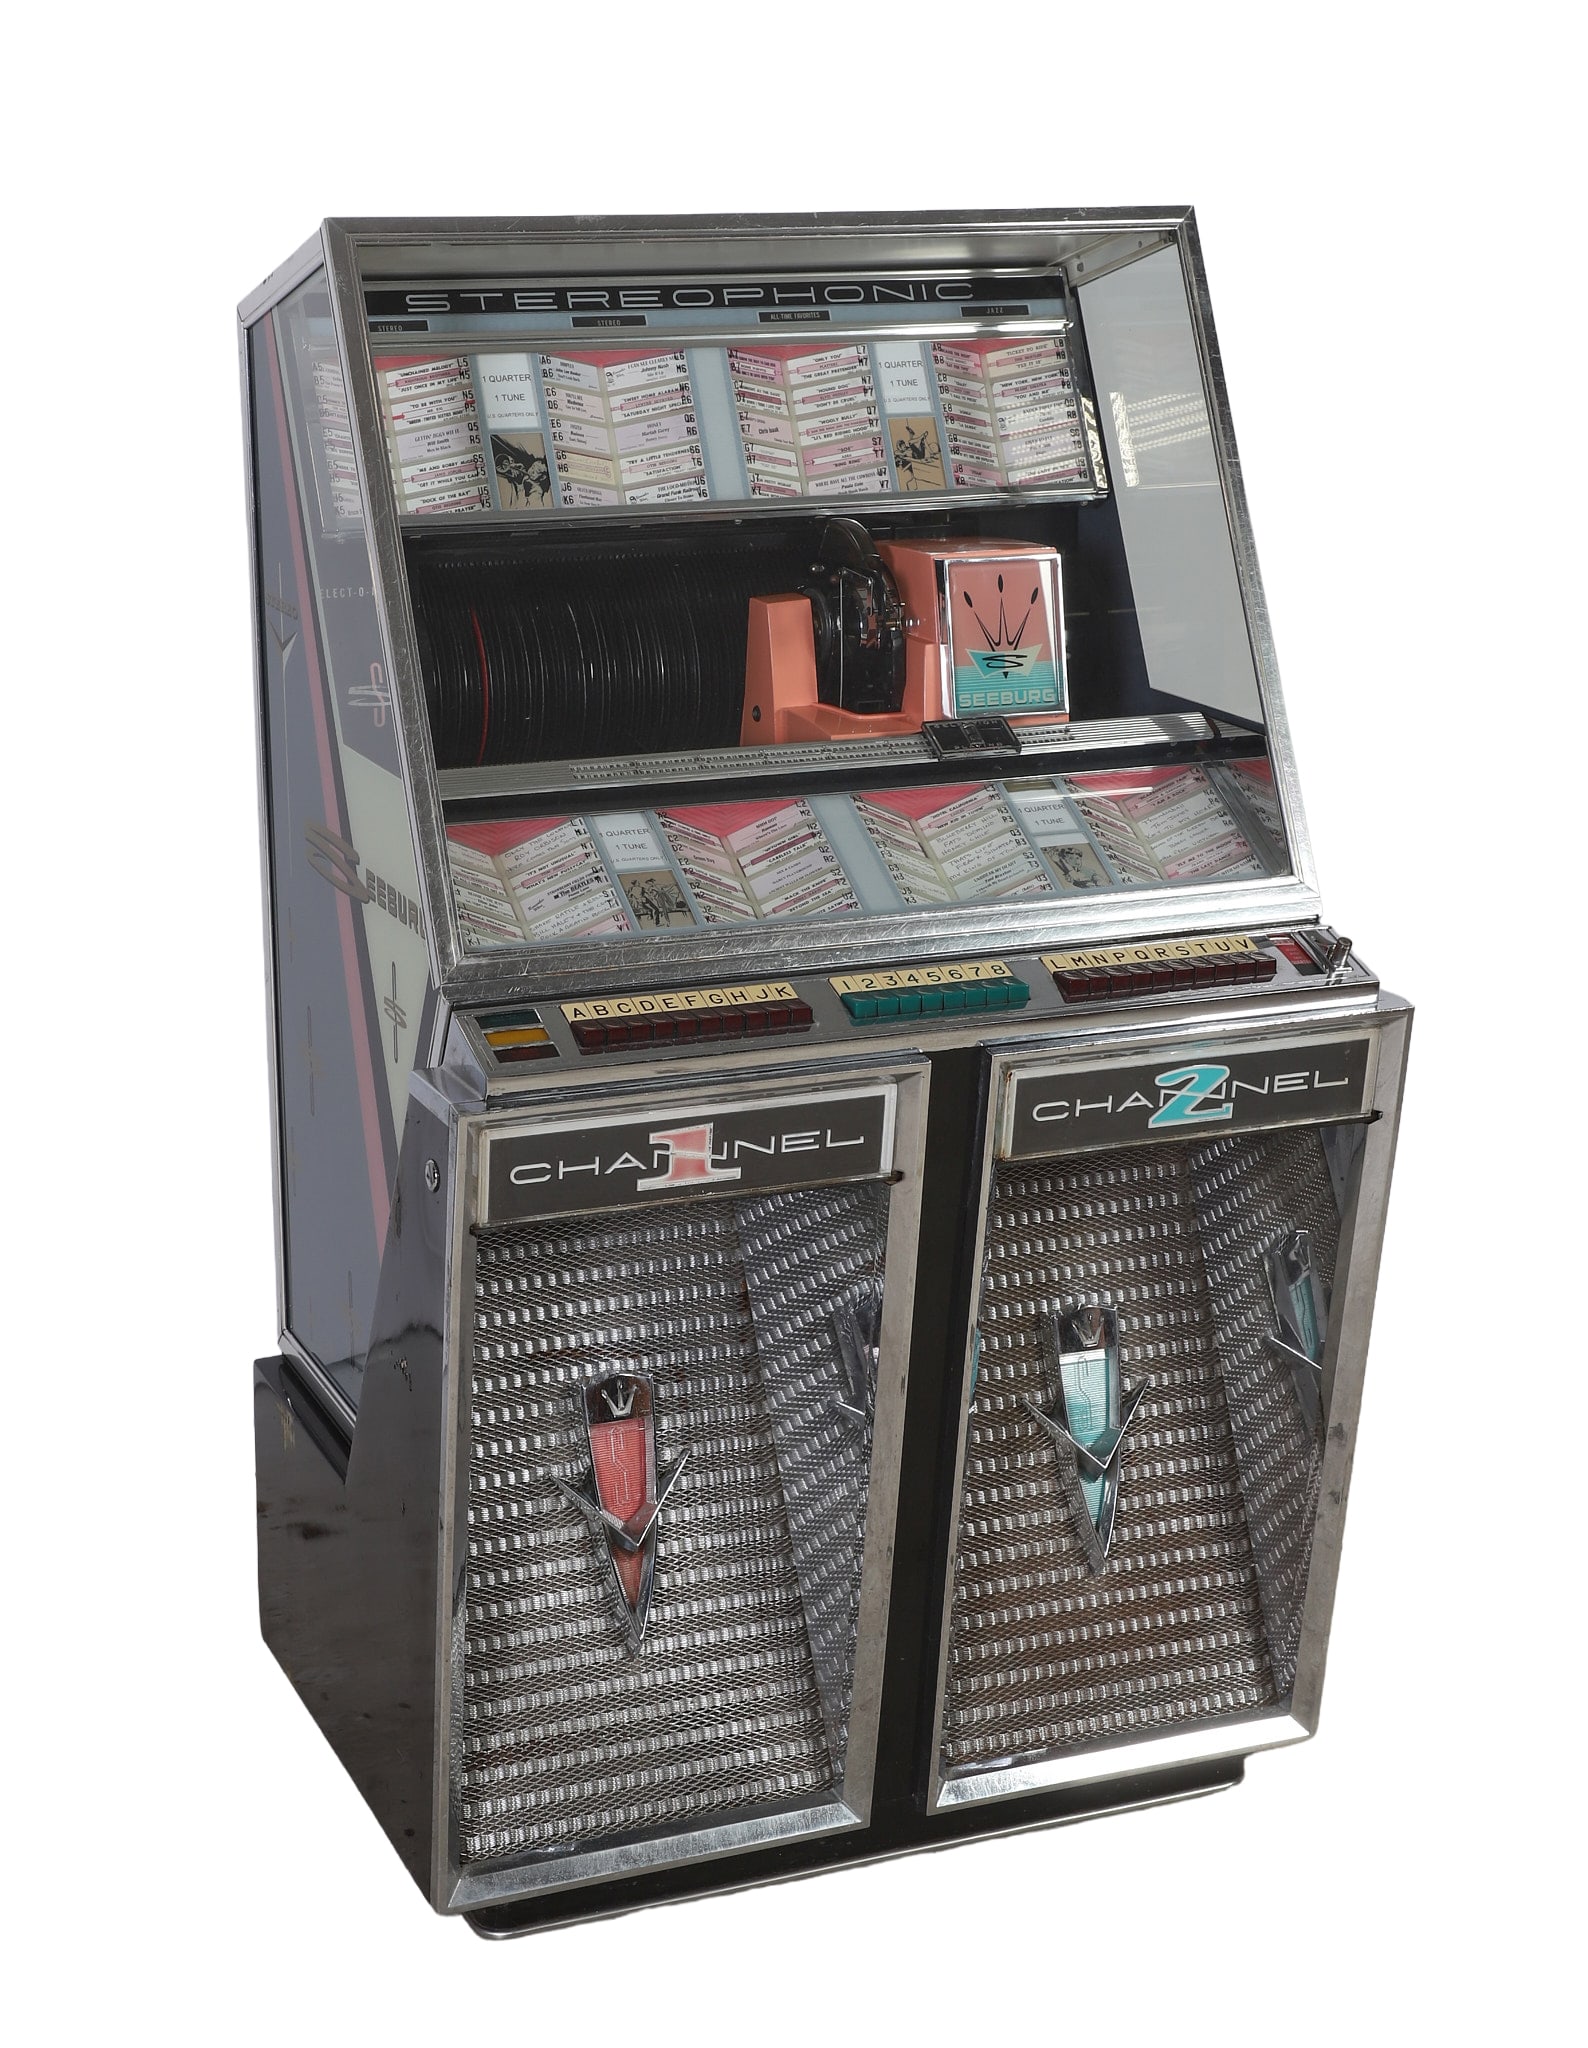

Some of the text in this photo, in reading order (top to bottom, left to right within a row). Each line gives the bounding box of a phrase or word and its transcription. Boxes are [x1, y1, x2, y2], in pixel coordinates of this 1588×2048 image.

[405, 283, 974, 312] STEREOPHONIC
[794, 311, 820, 320] FAVORITES
[377, 324, 403, 332] STEREO
[856, 345, 866, 354] L7
[457, 357, 469, 368] L5
[541, 355, 552, 365] A6
[884, 360, 924, 369] QUARTER
[542, 368, 554, 378] B6
[676, 365, 687, 373] M6
[488, 374, 532, 383] QUARTER
[861, 376, 871, 384] N7
[938, 373, 947, 382] C8
[896, 379, 918, 387] TUNE
[462, 390, 474, 400] N5
[545, 388, 557, 397] C6
[940, 386, 950, 395] D8
[501, 393, 526, 402] TUNE
[548, 400, 558, 409] D6
[943, 404, 952, 413] E8
[867, 406, 877, 415] Q7
[684, 414, 695, 423] Q6
[468, 422, 479, 431] Q5
[551, 419, 562, 428] E6
[686, 426, 697, 436] R6
[469, 435, 481, 444] R5
[872, 437, 882, 446] S7
[744, 442, 754, 452] G7
[556, 451, 567, 460] G6
[691, 457, 702, 467] T6
[562, 482, 572, 492] J6
[880, 480, 889, 489] V7
[478, 486, 489, 496] U5
[959, 688, 1055, 708] SEEBURG
[1024, 804, 1064, 813] QUARTER
[807, 822, 818, 830] N2
[606, 828, 650, 836] QUARTER
[672, 844, 684, 852] D2
[1022, 851, 1034, 859] S3
[831, 868, 843, 876] S2
[902, 887, 912, 895] J3
[904, 896, 917, 904] K3
[1050, 938, 1250, 969] L M N P Q R S T U V
[842, 964, 1006, 990] 1 2 3 4 5 6 7 8
[573, 986, 793, 1018] A B C D E F G H J K
[1032, 1064, 1349, 1129] CHANNEL 2
[509, 1122, 864, 1192] CHANNEL 1
